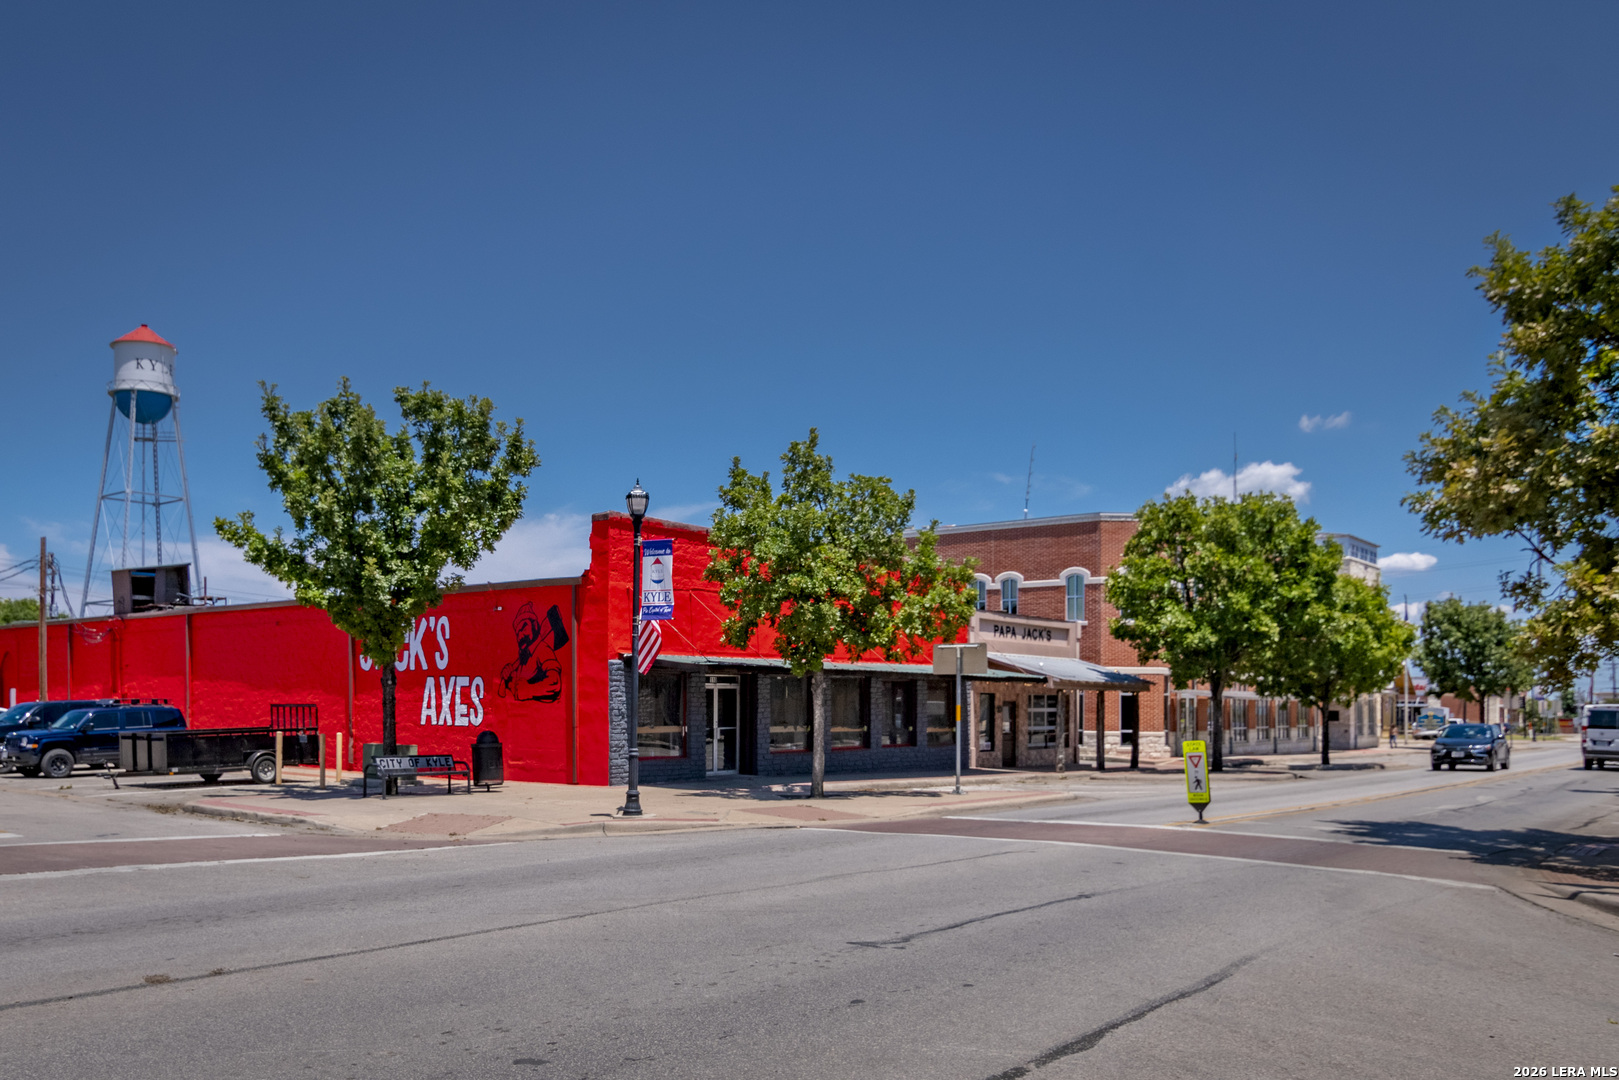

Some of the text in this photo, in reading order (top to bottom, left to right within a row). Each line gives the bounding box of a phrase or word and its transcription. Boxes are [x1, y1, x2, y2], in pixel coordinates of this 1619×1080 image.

[644, 547, 665, 556] Welcome
[643, 591, 672, 603] KYLE
[993, 624, 1052, 642] PAPA JACK'S
[420, 675, 485, 727] AXES
[379, 757, 451, 769] CITY OF KYLE
